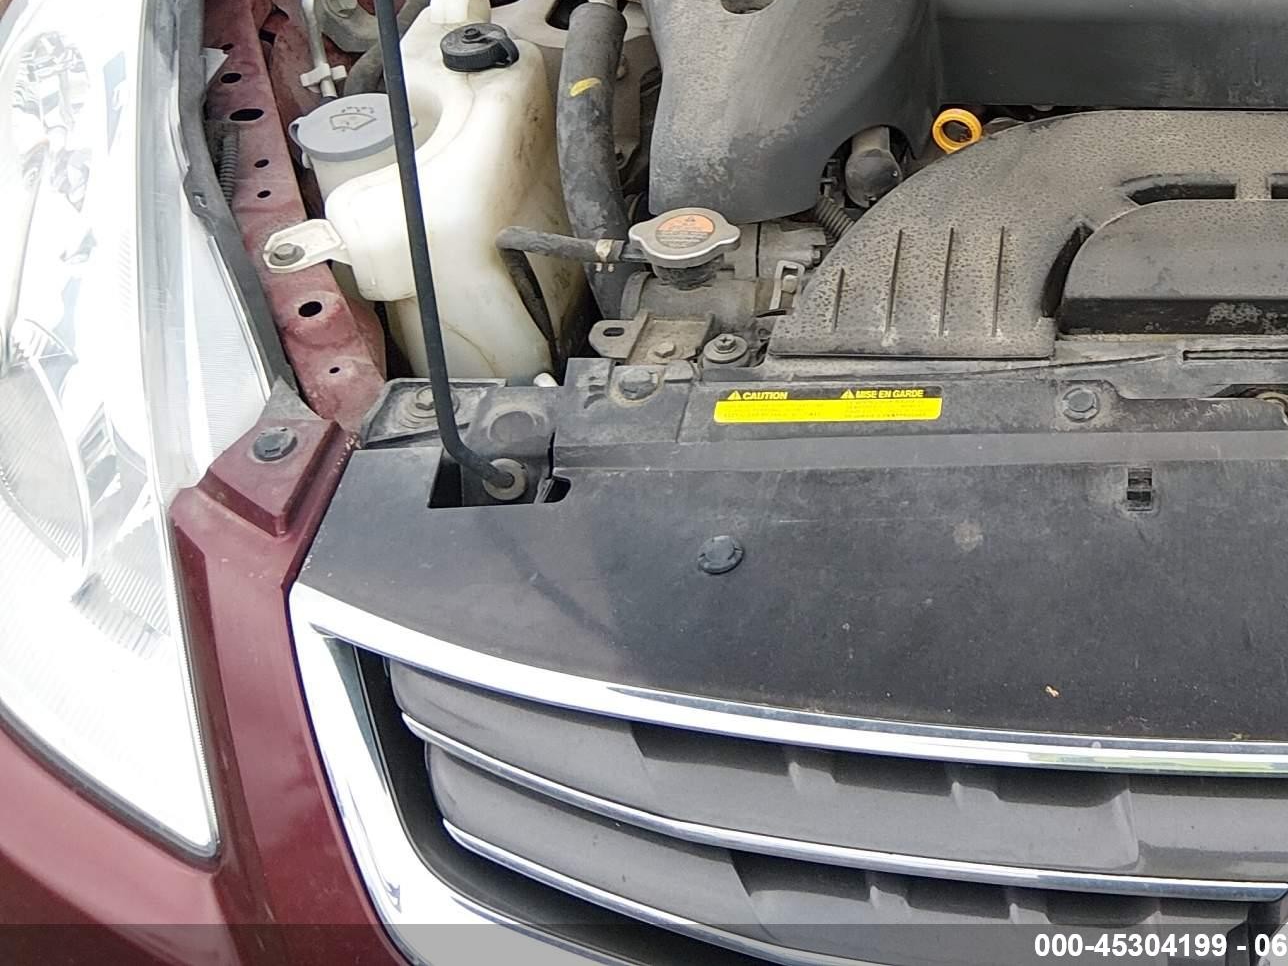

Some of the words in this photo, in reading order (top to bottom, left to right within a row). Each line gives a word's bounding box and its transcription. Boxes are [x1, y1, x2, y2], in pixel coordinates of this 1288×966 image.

[742, 391, 789, 401] CAUTION
[855, 390, 878, 399] MISE
[878, 389, 893, 399] EN
[892, 389, 925, 398] GARDE
